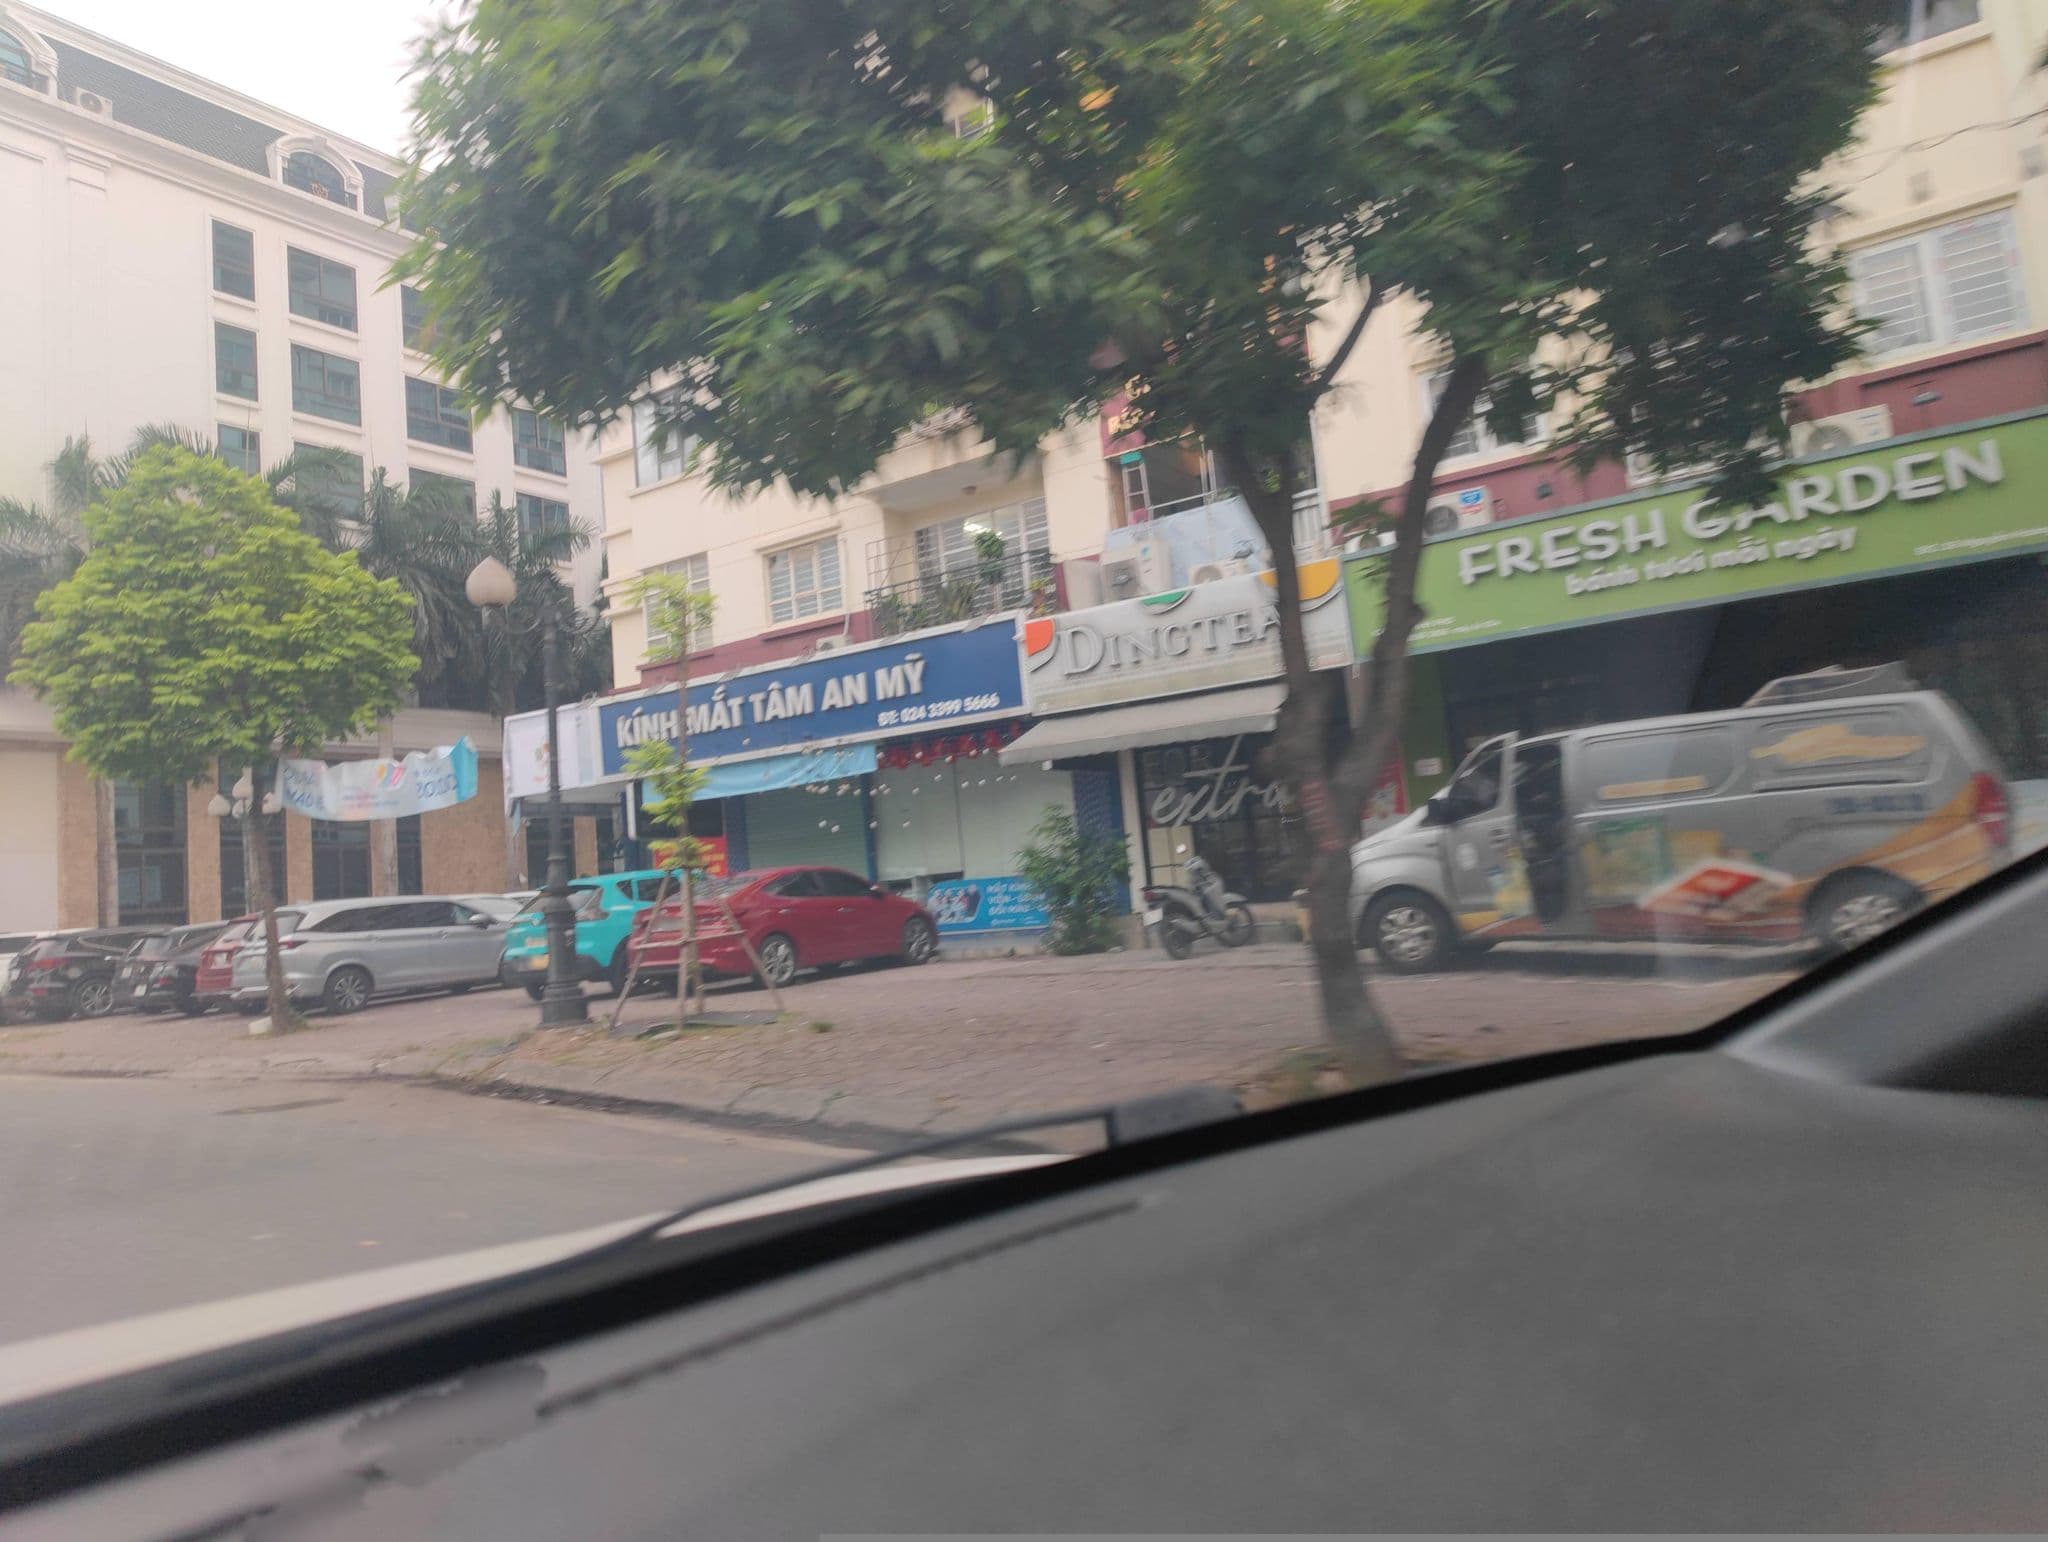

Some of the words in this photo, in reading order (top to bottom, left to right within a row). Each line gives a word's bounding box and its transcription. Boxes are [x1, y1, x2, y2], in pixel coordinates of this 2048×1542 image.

[1458, 508, 1668, 586] FRESH
[1681, 437, 2006, 540] GARDEN
[1565, 566, 1640, 596] bánh
[1710, 535, 1769, 569] mỗi
[1775, 526, 1858, 560] ngày
[616, 705, 680, 749] KÍNH
[685, 687, 745, 737] MẮT
[749, 680, 815, 724] TÂM
[820, 671, 869, 712] AN
[874, 652, 927, 700] MỸ
[900, 704, 927, 722] 024
[1150, 734, 1294, 828] extra
